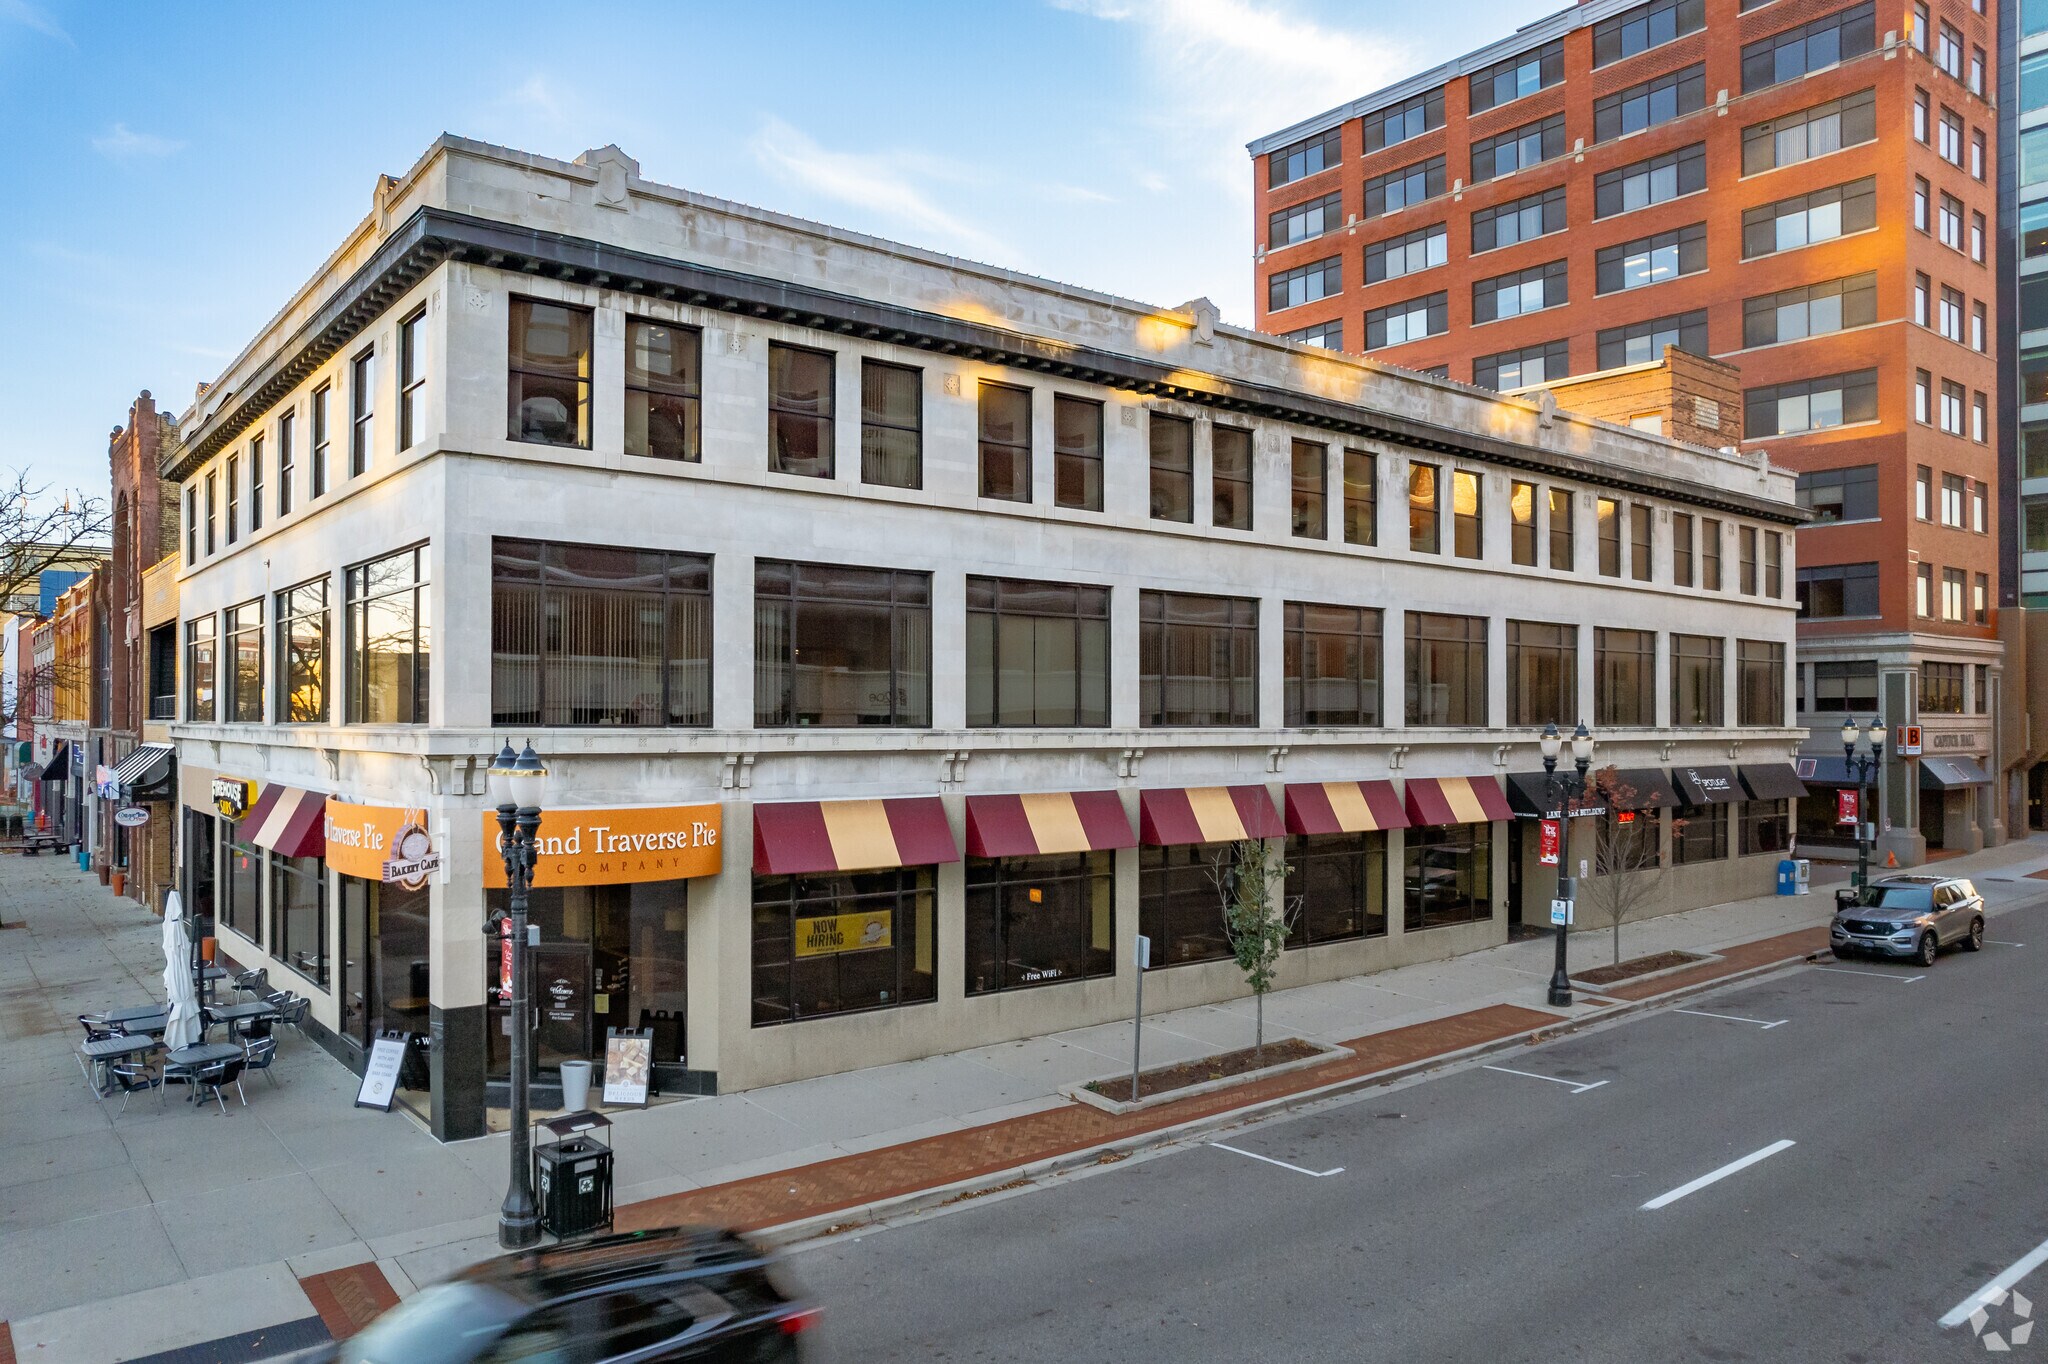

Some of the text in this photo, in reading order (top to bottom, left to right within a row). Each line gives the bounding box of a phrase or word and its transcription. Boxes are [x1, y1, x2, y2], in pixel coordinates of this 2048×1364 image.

[1909, 730, 1919, 745] B
[1934, 734, 1975, 747] CAPITOL HALL
[211, 780, 242, 810] FIREHOUSE
[219, 799, 232, 816] SUBS
[1546, 810, 1579, 819] LANARK
[1580, 807, 1605, 816] BUILDING
[329, 816, 361, 847] Traverse
[363, 822, 384, 850] Pie
[495, 821, 717, 855] and Traverse Pie
[391, 864, 419, 878] BAKERY
[556, 857, 680, 875] COMPANY
[813, 918, 837, 934] NOW
[806, 932, 844, 948] HIRING
[1026, 972, 1041, 981] Free
